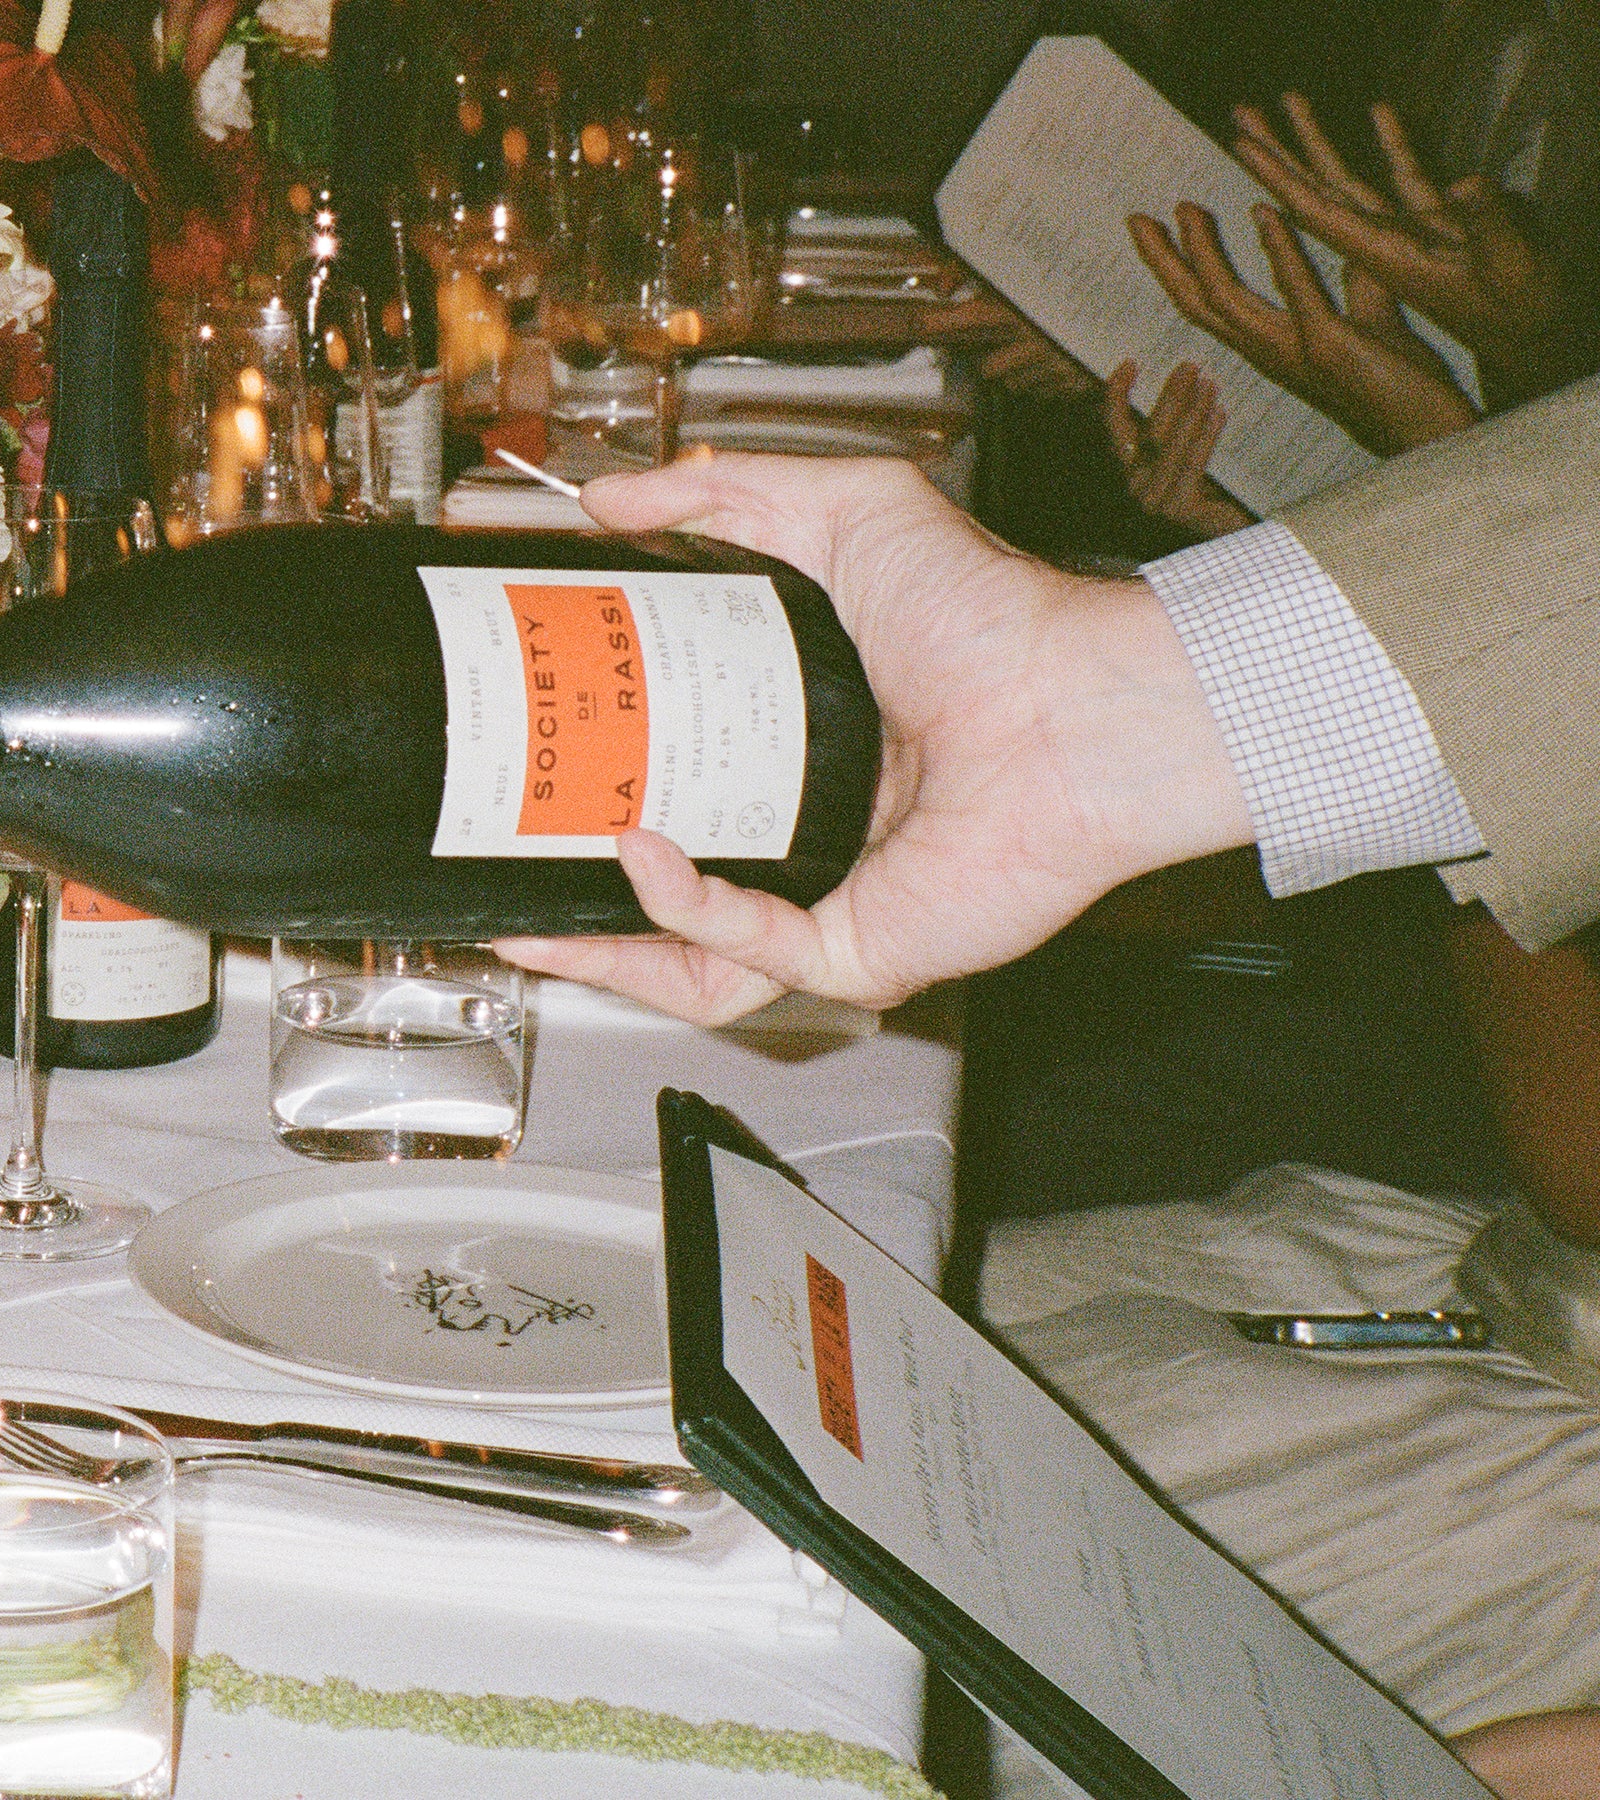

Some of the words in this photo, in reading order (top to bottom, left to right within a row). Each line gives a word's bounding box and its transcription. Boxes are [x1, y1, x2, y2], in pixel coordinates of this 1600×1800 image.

[484, 608, 503, 647] BRUT
[639, 586, 673, 681] CHARDONNAY
[597, 594, 637, 711] RASSI
[714, 661, 727, 681] BY
[468, 665, 483, 742] VINTAGE
[525, 617, 558, 800] SOCIETY
[578, 691, 591, 720] DE
[684, 639, 705, 778] DEALCOHOLISED
[494, 763, 509, 806] NEUE
[609, 777, 636, 827] LA
[707, 809, 724, 839] ALC
[68, 902, 102, 915] LA
